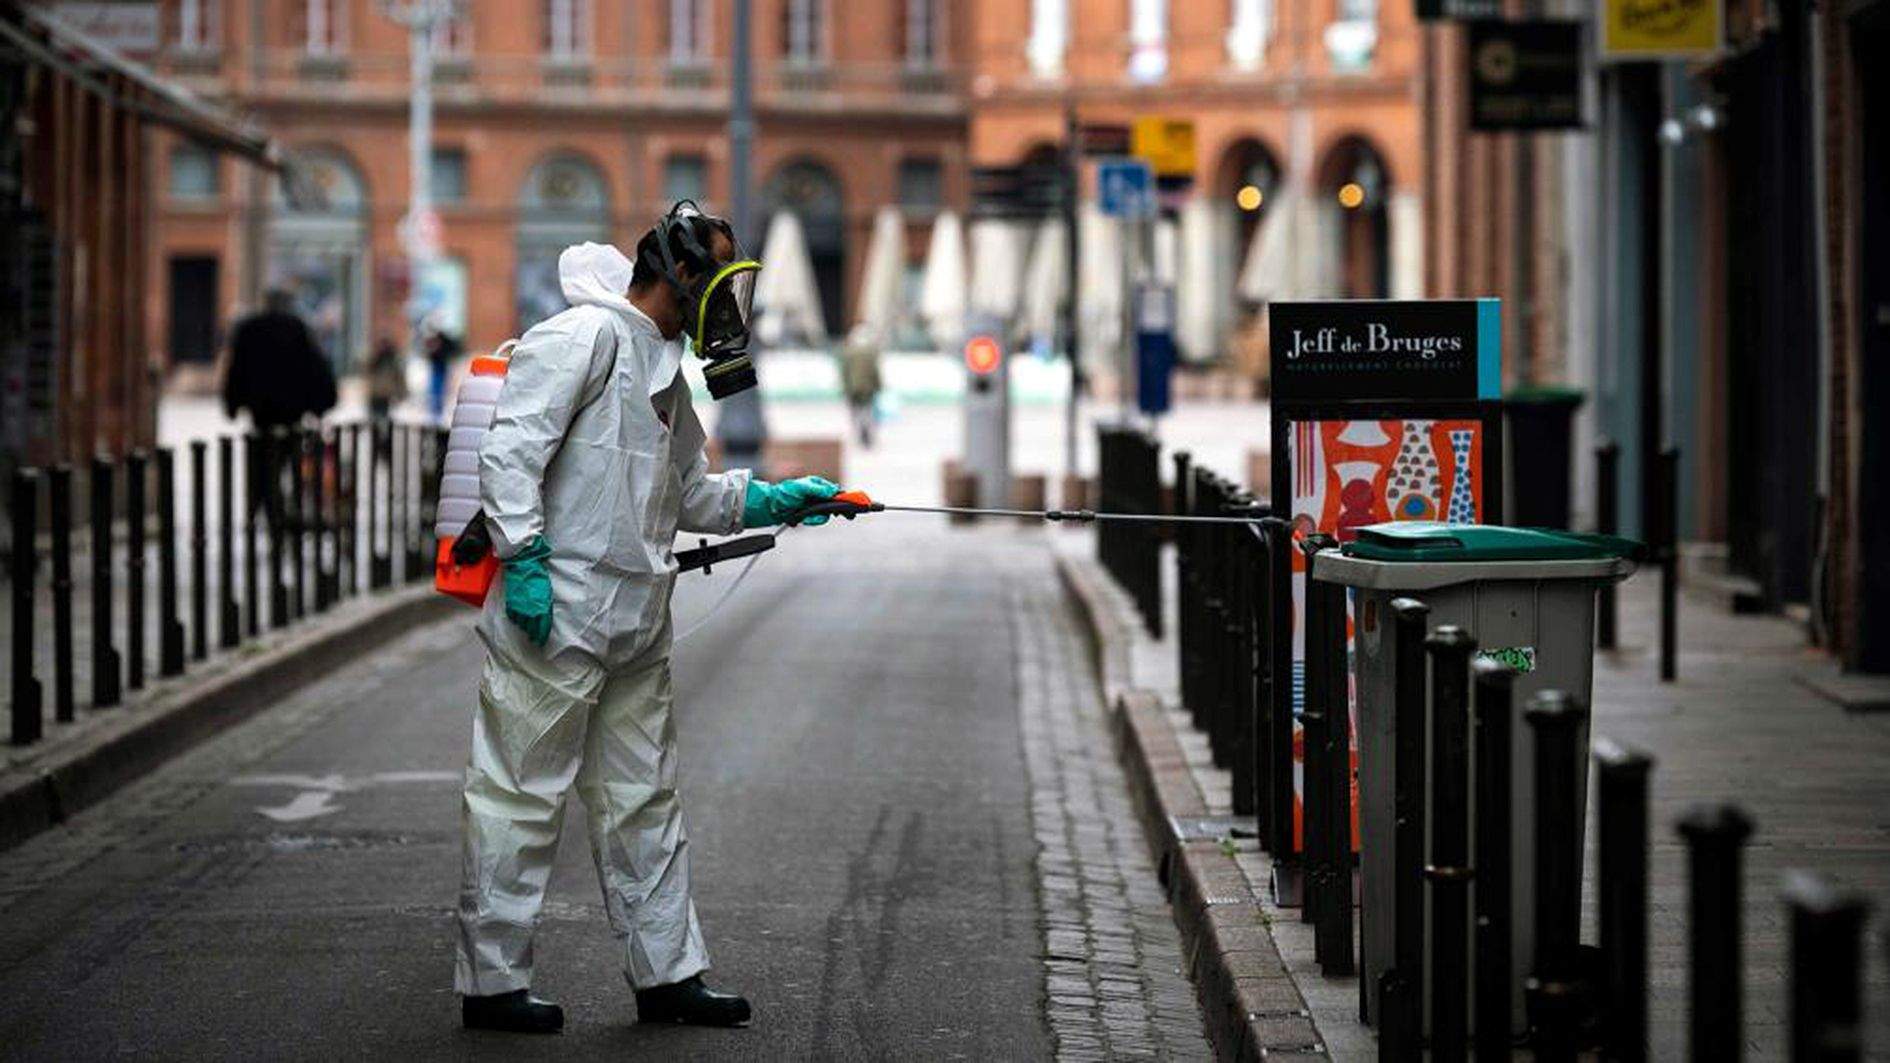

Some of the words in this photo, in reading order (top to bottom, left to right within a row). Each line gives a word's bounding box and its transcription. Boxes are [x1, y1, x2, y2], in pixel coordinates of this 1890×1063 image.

[1287, 328, 1337, 358] Jeff
[1341, 335, 1362, 353] de
[1367, 323, 1462, 359] Bruges
